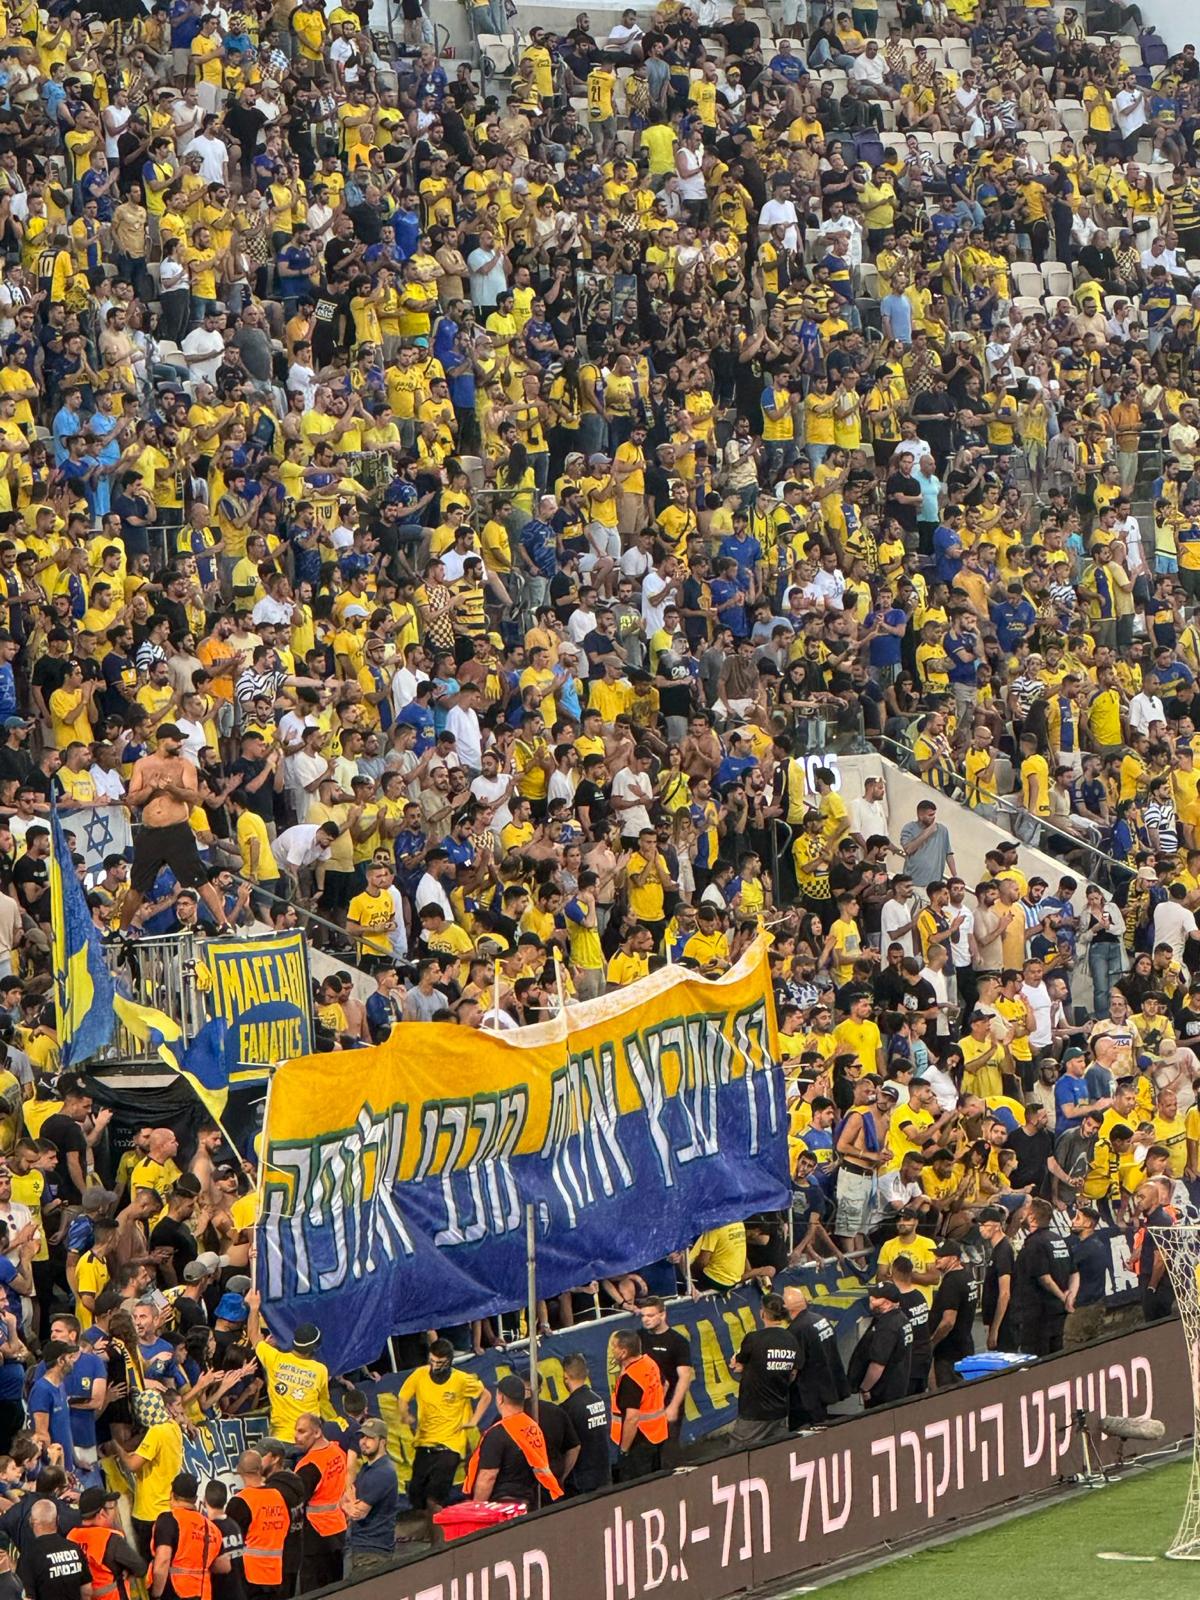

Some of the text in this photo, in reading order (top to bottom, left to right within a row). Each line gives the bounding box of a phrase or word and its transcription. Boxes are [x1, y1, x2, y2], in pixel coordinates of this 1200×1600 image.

[39, 256, 55, 278] 10
[218, 951, 304, 1029] MACCABI
[239, 1016, 303, 1066] FANATICS
[789, 1449, 852, 1543] של
[871, 1402, 1005, 1518] היוקרה
